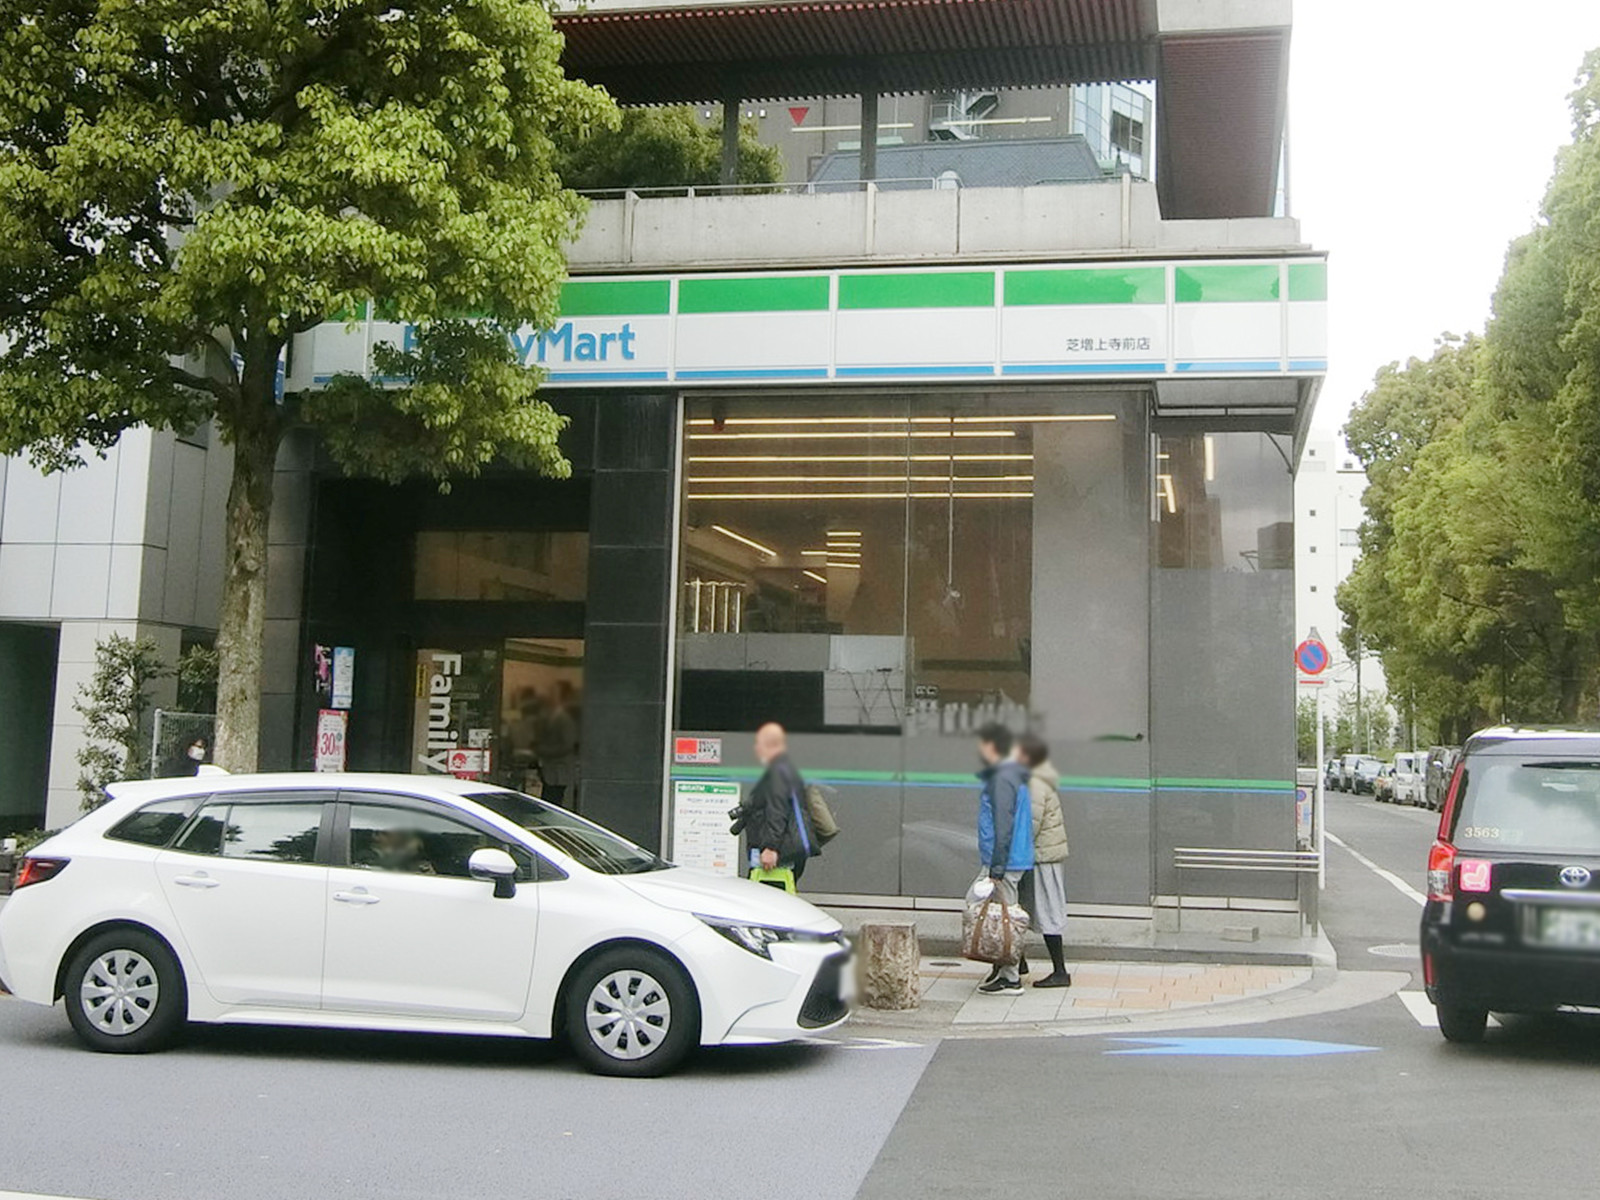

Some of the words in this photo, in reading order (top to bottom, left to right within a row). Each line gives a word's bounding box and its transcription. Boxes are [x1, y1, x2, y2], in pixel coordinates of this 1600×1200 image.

[404, 322, 636, 364] FyMart
[1066, 337, 1151, 352] 芝増上寺前店
[418, 653, 462, 772] Family
[1464, 827, 1499, 838] 3563
